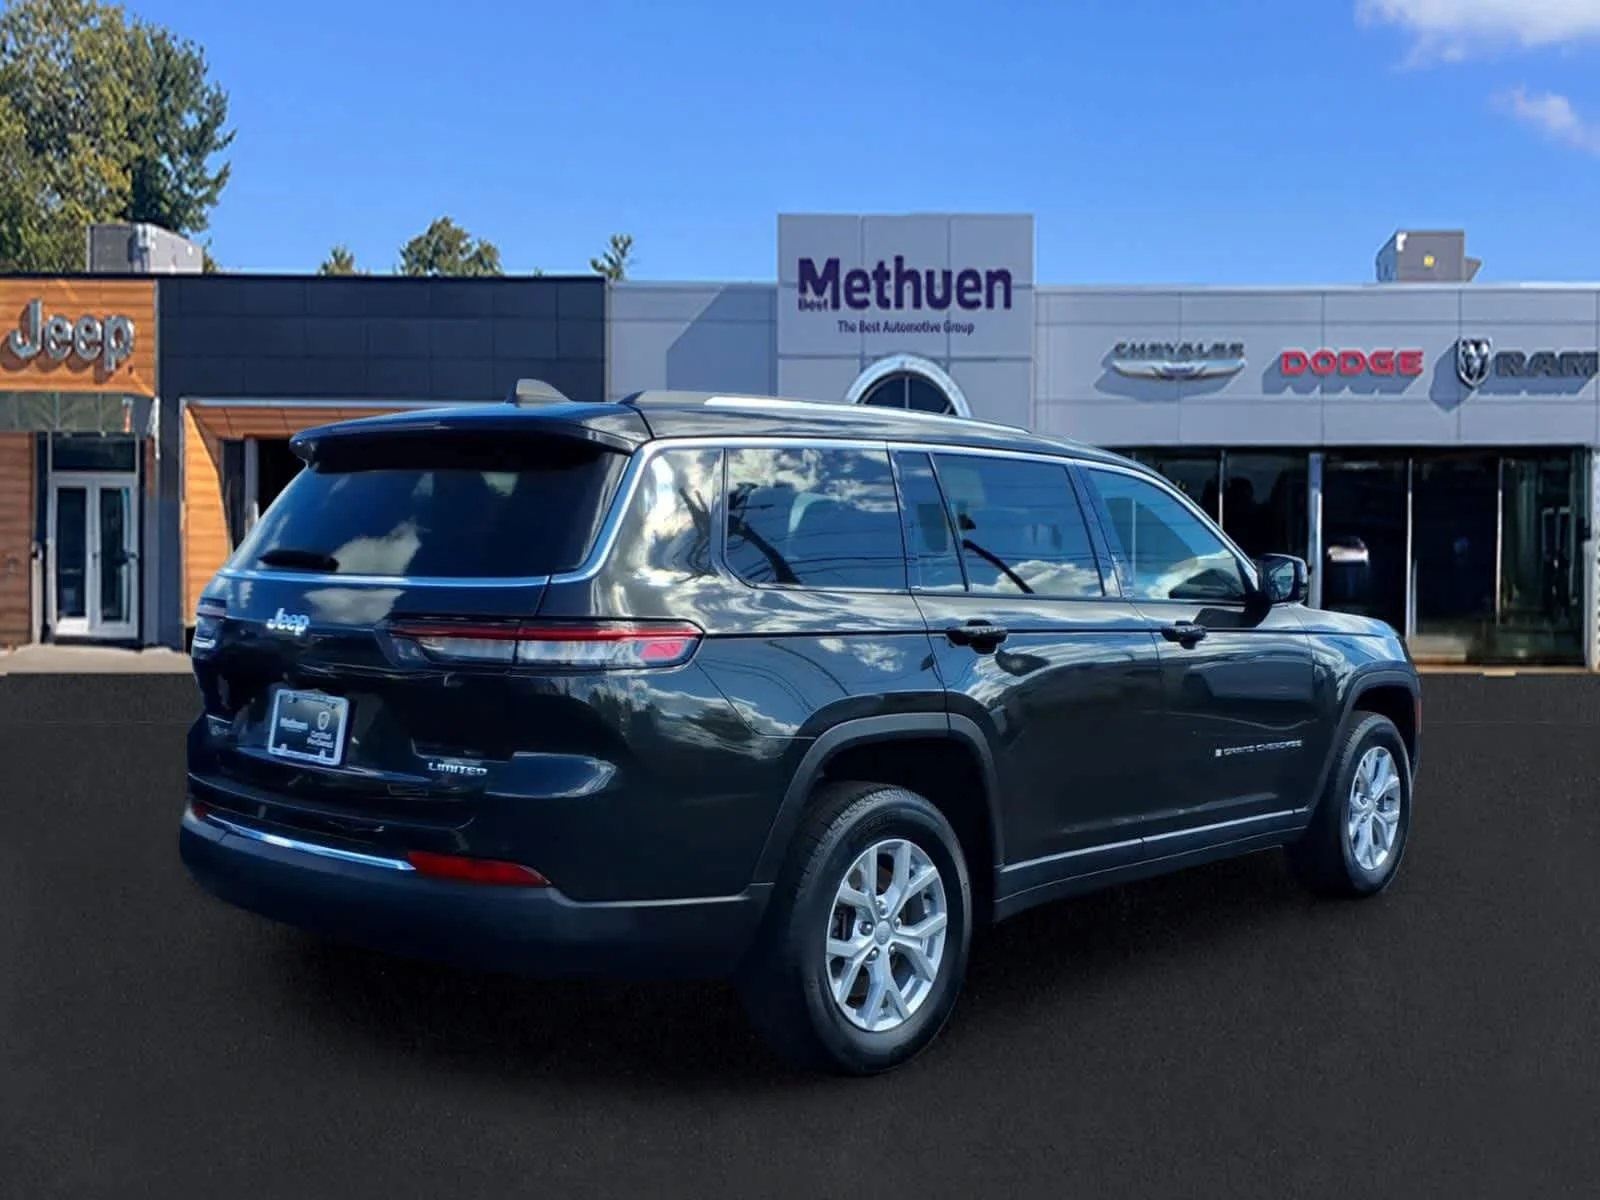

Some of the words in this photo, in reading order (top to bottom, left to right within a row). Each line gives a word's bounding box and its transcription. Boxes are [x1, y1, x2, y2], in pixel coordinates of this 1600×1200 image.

[798, 255, 1012, 311] Methuen
[798, 297, 829, 312] Best
[9, 299, 135, 372] Jeep
[837, 319, 857, 333] The
[859, 319, 880, 333] Best
[883, 319, 941, 333] Automotive
[943, 319, 975, 336] Group
[1113, 342, 1245, 360] CHRYSLER
[1281, 349, 1424, 376] DODGE
[1495, 351, 1598, 377] RAM
[266, 607, 310, 635] Jeep
[428, 761, 488, 777] LIMITED
